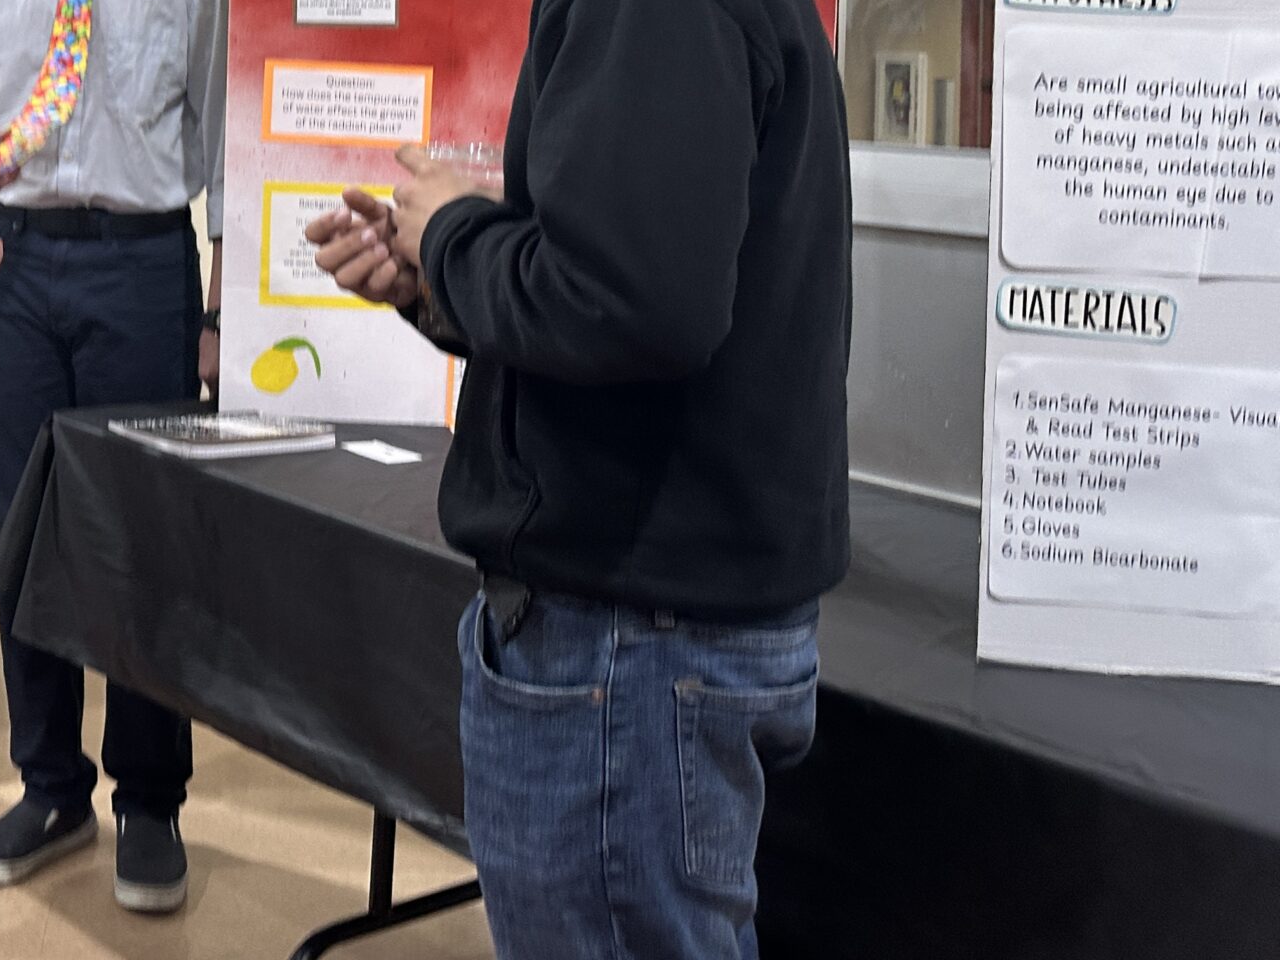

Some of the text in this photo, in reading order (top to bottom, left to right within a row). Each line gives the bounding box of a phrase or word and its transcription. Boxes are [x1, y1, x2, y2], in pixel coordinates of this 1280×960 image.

[334, 89, 351, 102] the
[1033, 72, 1068, 92] Are
[1077, 74, 1127, 95] small
[1136, 77, 1247, 100] agricultural
[1034, 98, 1083, 122] being
[1093, 100, 1171, 123] affected
[1181, 104, 1202, 128] by
[1211, 104, 1249, 130] high
[1054, 123, 1074, 144] of
[1082, 126, 1136, 152] heavy
[1146, 130, 1208, 152] metals
[1217, 131, 1256, 152] such
[1036, 153, 1276, 180] manganese, undetectable
[1065, 177, 1273, 207] the human eye due to
[1009, 284, 1169, 336] MATERIALS
[1028, 390, 1099, 415] SenSafe
[1026, 415, 1200, 452] & Read Test Strips
[1025, 440, 1081, 464] Water
[1088, 448, 1161, 473] samples
[1032, 465, 1067, 488] Test
[1077, 469, 1126, 493] Tubes
[1022, 491, 1107, 517] Notebook
[1022, 515, 1080, 540] Gloves
[1020, 539, 1084, 565] Sodium
[1092, 545, 1199, 576] Bicarbonate
